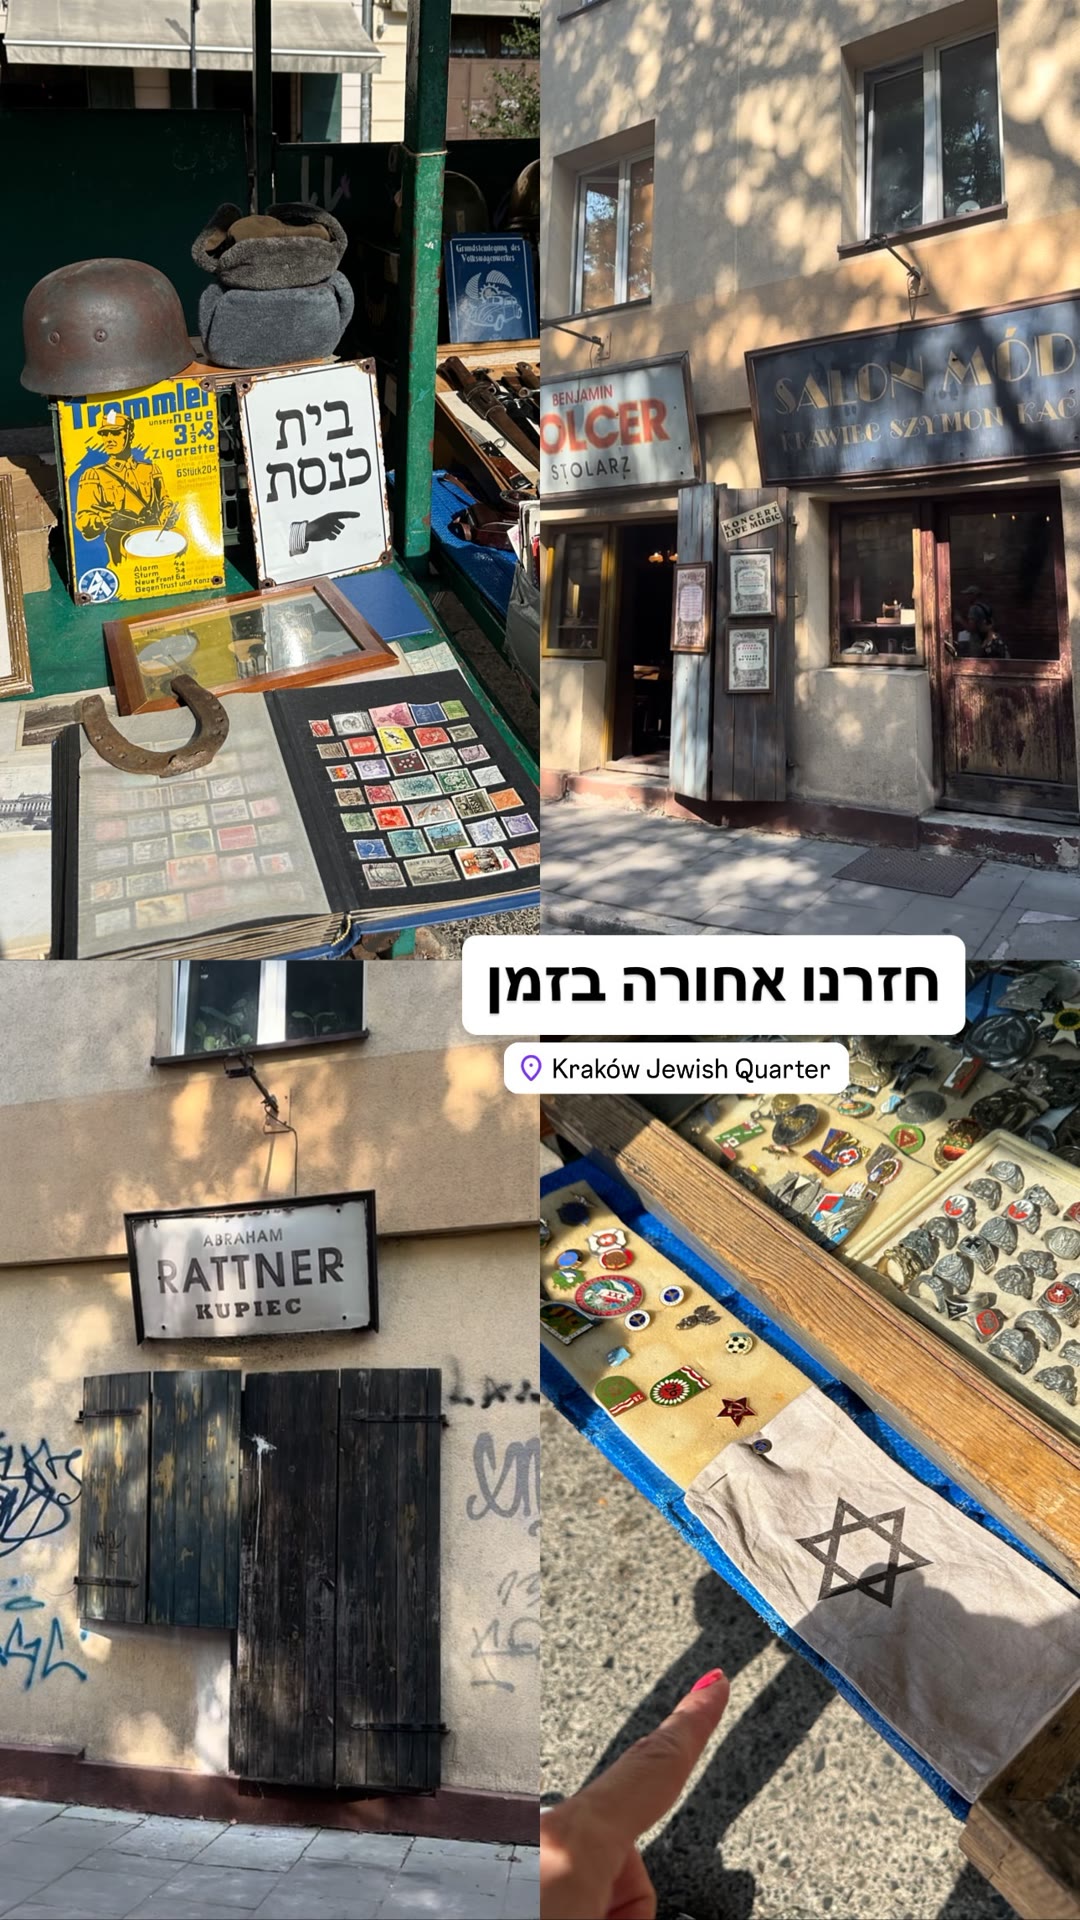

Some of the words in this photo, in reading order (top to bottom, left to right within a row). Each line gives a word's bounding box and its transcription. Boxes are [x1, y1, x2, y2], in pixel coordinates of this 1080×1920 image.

[511, 243, 521, 252] des
[461, 254, 515, 264] Volkswagenwerkes
[775, 355, 925, 415] SALON
[943, 327, 1076, 391] MÓD
[552, 384, 613, 407] BENJAMIN
[149, 418, 173, 426] unsere
[173, 410, 214, 424] neue
[276, 399, 353, 450] בית
[779, 422, 882, 450] KRAWIEC
[890, 408, 1004, 439] SZYMON
[152, 444, 216, 460] Zigarette
[266, 447, 373, 503] כנסת
[551, 456, 631, 480] STOLARZ
[723, 506, 778, 531] KONCERT
[726, 524, 748, 539] LIVE
[750, 513, 781, 530] MUSIC
[134, 571, 159, 580] Sturm
[156, 575, 174, 583] Front
[135, 584, 160, 593] Gegen
[366, 843, 378, 856] 2
[203, 1228, 283, 1247] ABRAHAM
[158, 1247, 344, 1294] RATTNER
[195, 1298, 302, 1320] KUPIEC
